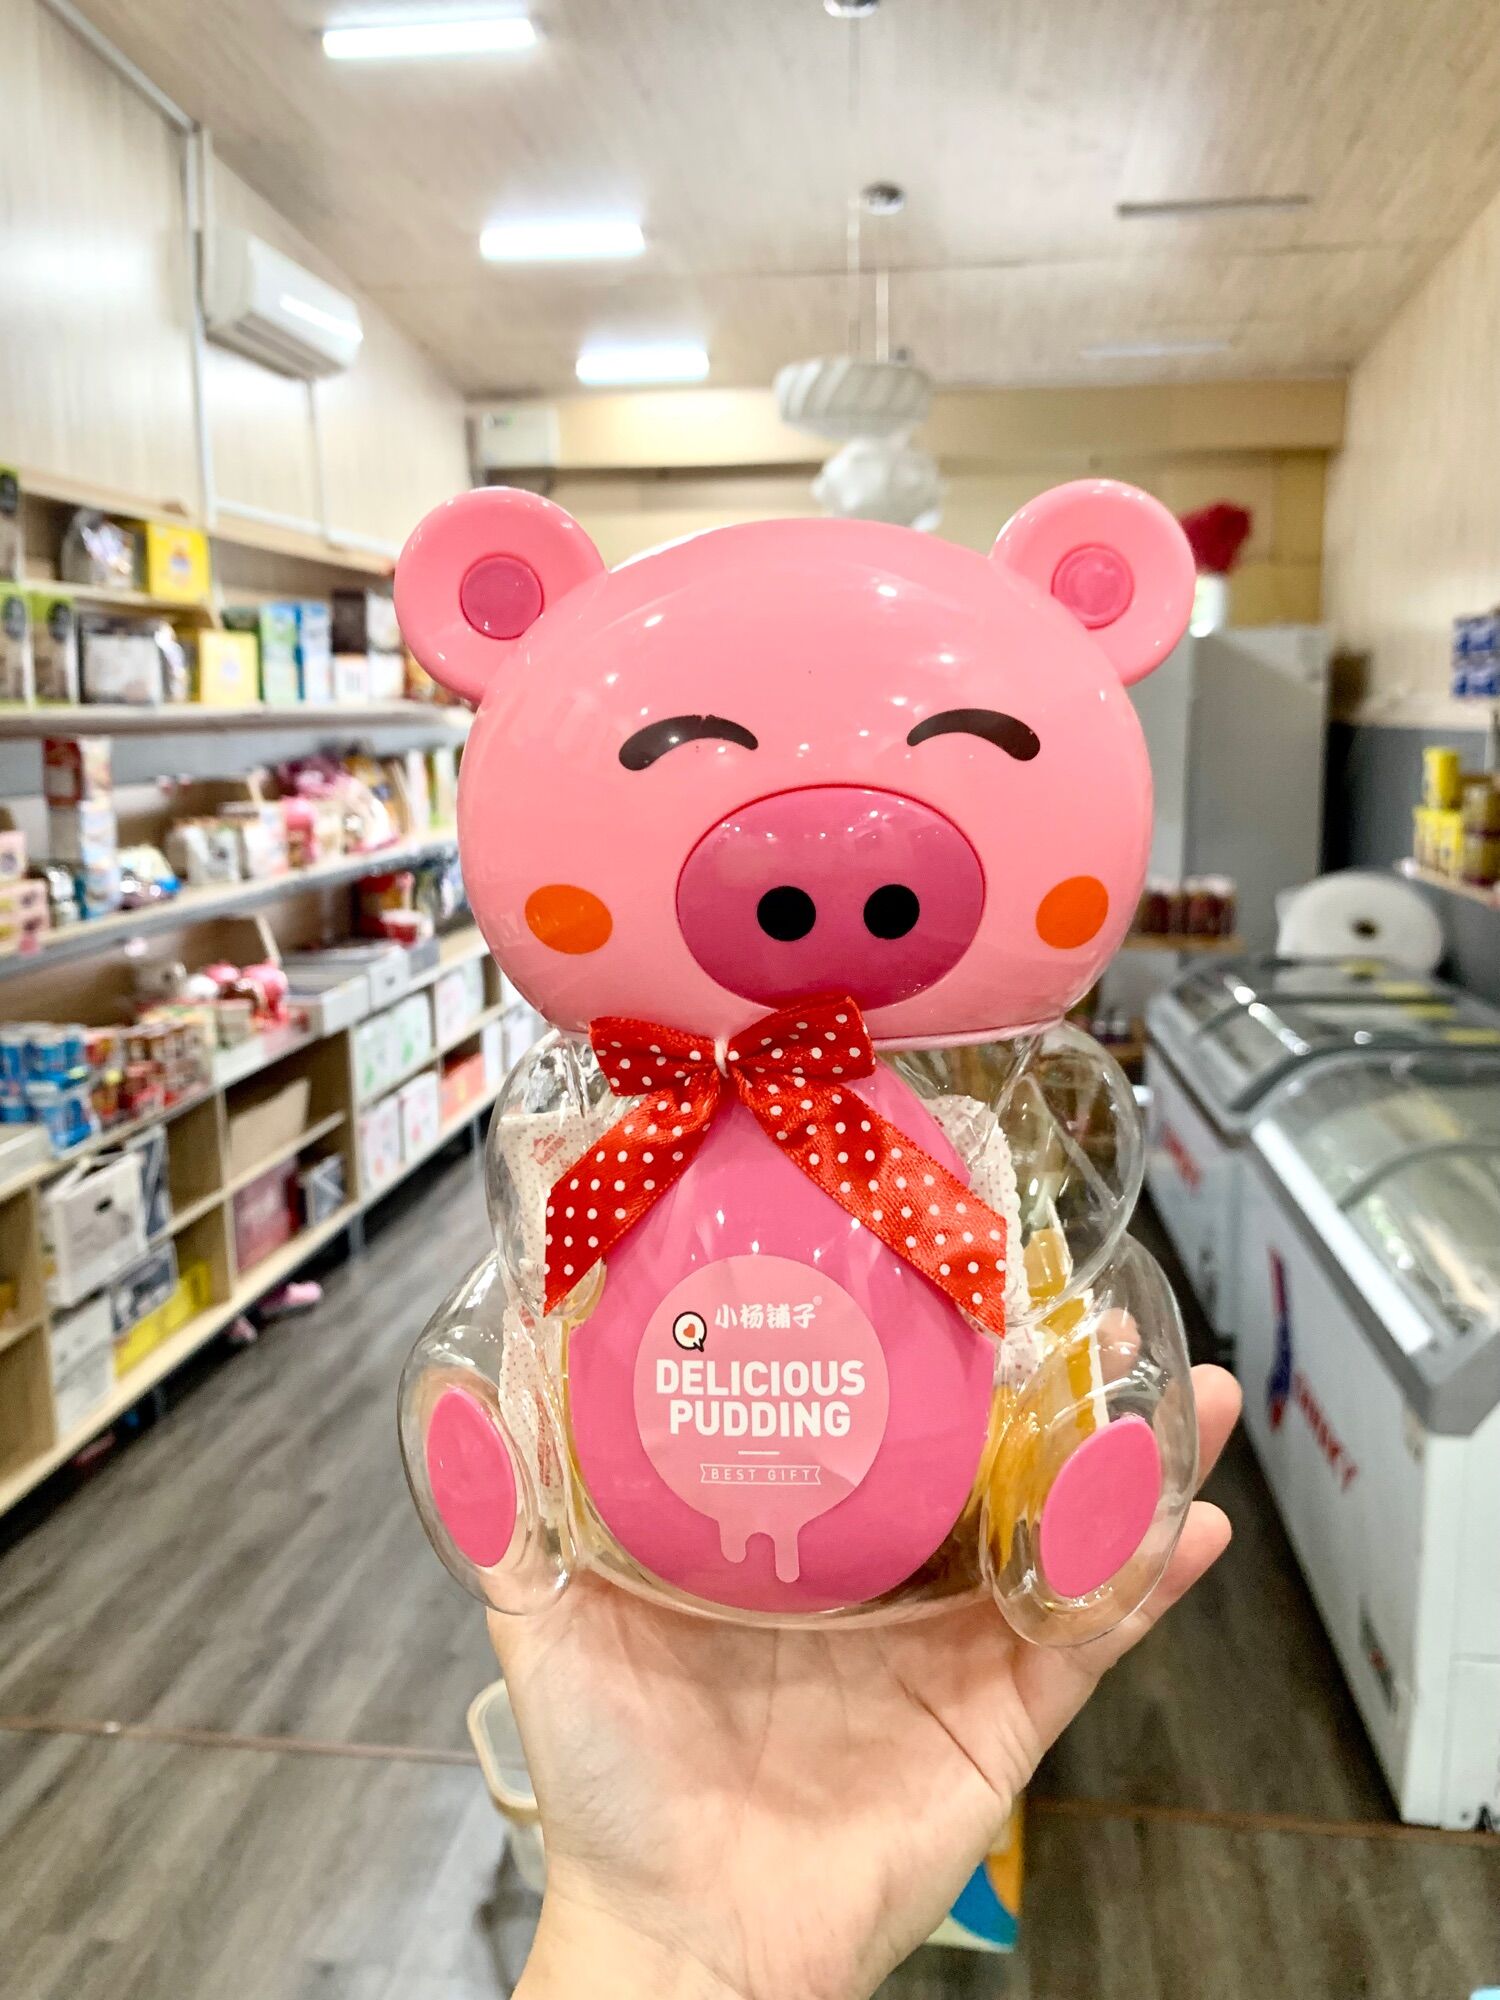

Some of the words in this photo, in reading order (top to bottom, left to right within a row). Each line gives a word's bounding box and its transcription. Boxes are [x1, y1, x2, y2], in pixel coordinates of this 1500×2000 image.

[714, 1303, 816, 1329] 小杨铺子
[656, 1359, 866, 1396] DELICIOUS
[669, 1399, 851, 1437] PUDDING
[711, 1467, 756, 1481] BEST
[767, 1469, 810, 1482] GIFT
